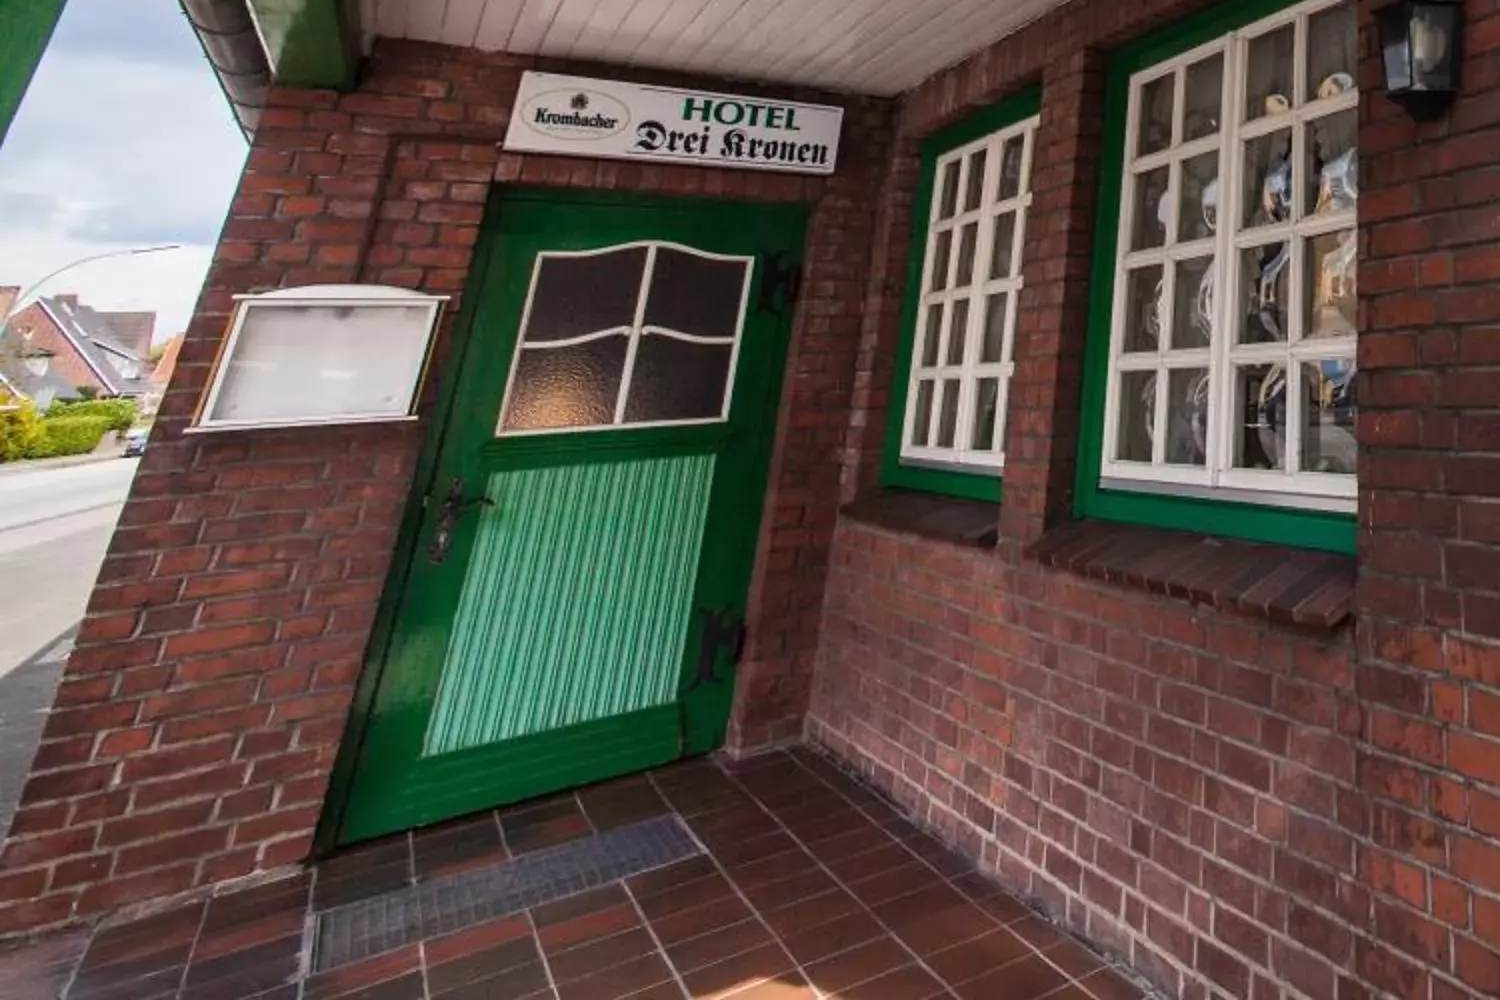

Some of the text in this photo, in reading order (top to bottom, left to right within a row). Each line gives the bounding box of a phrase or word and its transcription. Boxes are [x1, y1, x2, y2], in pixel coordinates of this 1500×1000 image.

[533, 106, 619, 129] Krombacher
[682, 97, 800, 131] HOTEL
[636, 119, 829, 165] Drei Kronen
